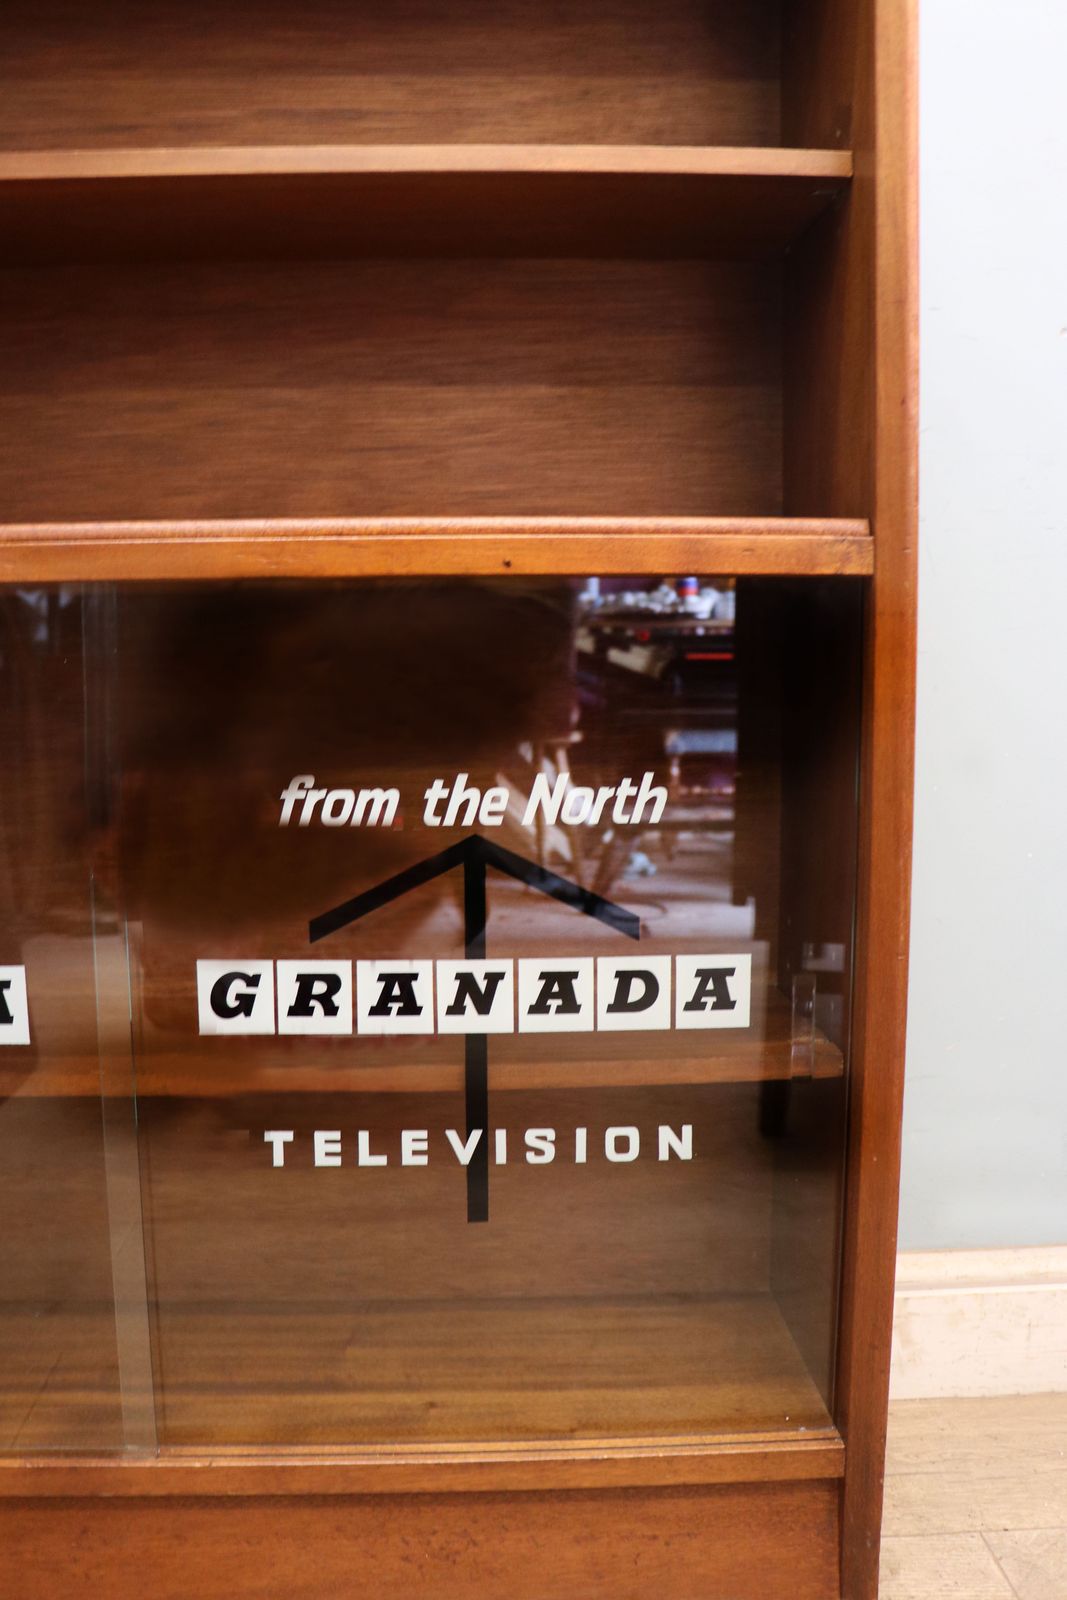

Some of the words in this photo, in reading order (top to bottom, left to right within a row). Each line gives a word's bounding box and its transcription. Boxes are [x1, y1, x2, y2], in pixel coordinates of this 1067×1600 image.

[278, 774, 400, 827] from
[423, 772, 509, 827] the
[521, 771, 668, 826] North
[209, 967, 738, 1020] GRANADA
[263, 1124, 694, 1168] TELEVISION
